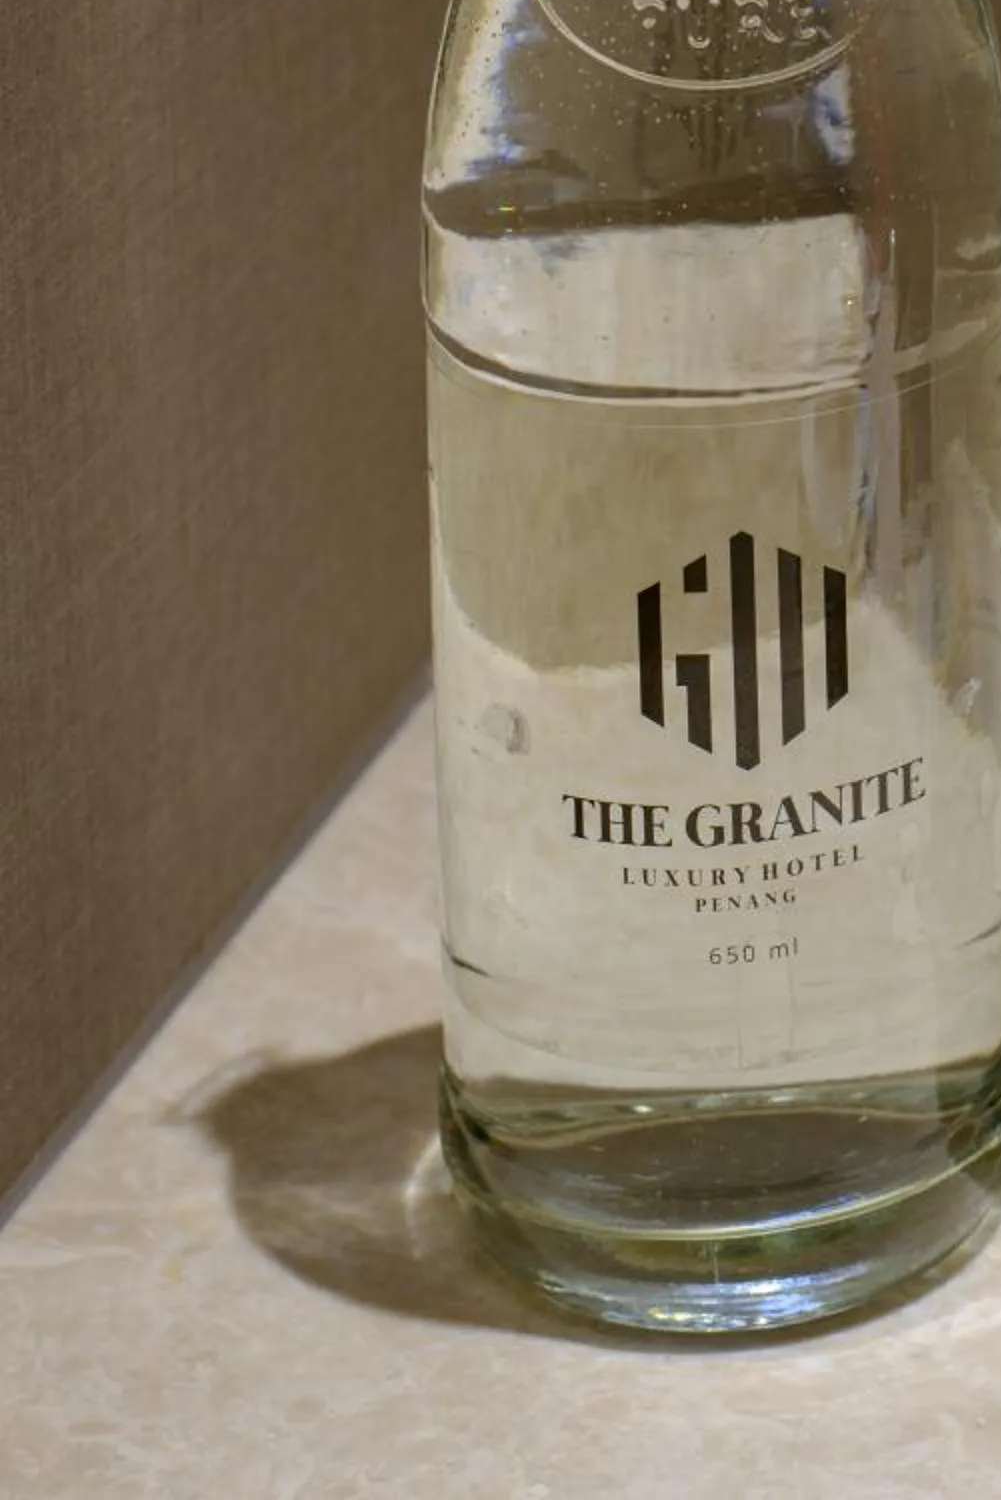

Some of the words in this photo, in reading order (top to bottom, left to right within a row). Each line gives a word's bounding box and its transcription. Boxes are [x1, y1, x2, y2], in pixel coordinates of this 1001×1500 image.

[560, 792, 674, 849] THE
[684, 756, 928, 850] GRANITE
[621, 865, 751, 888] LUXURY
[761, 843, 865, 882] HOTEL
[694, 888, 798, 914] PENANG
[707, 944, 757, 966] 650
[768, 936, 800, 960] ml
